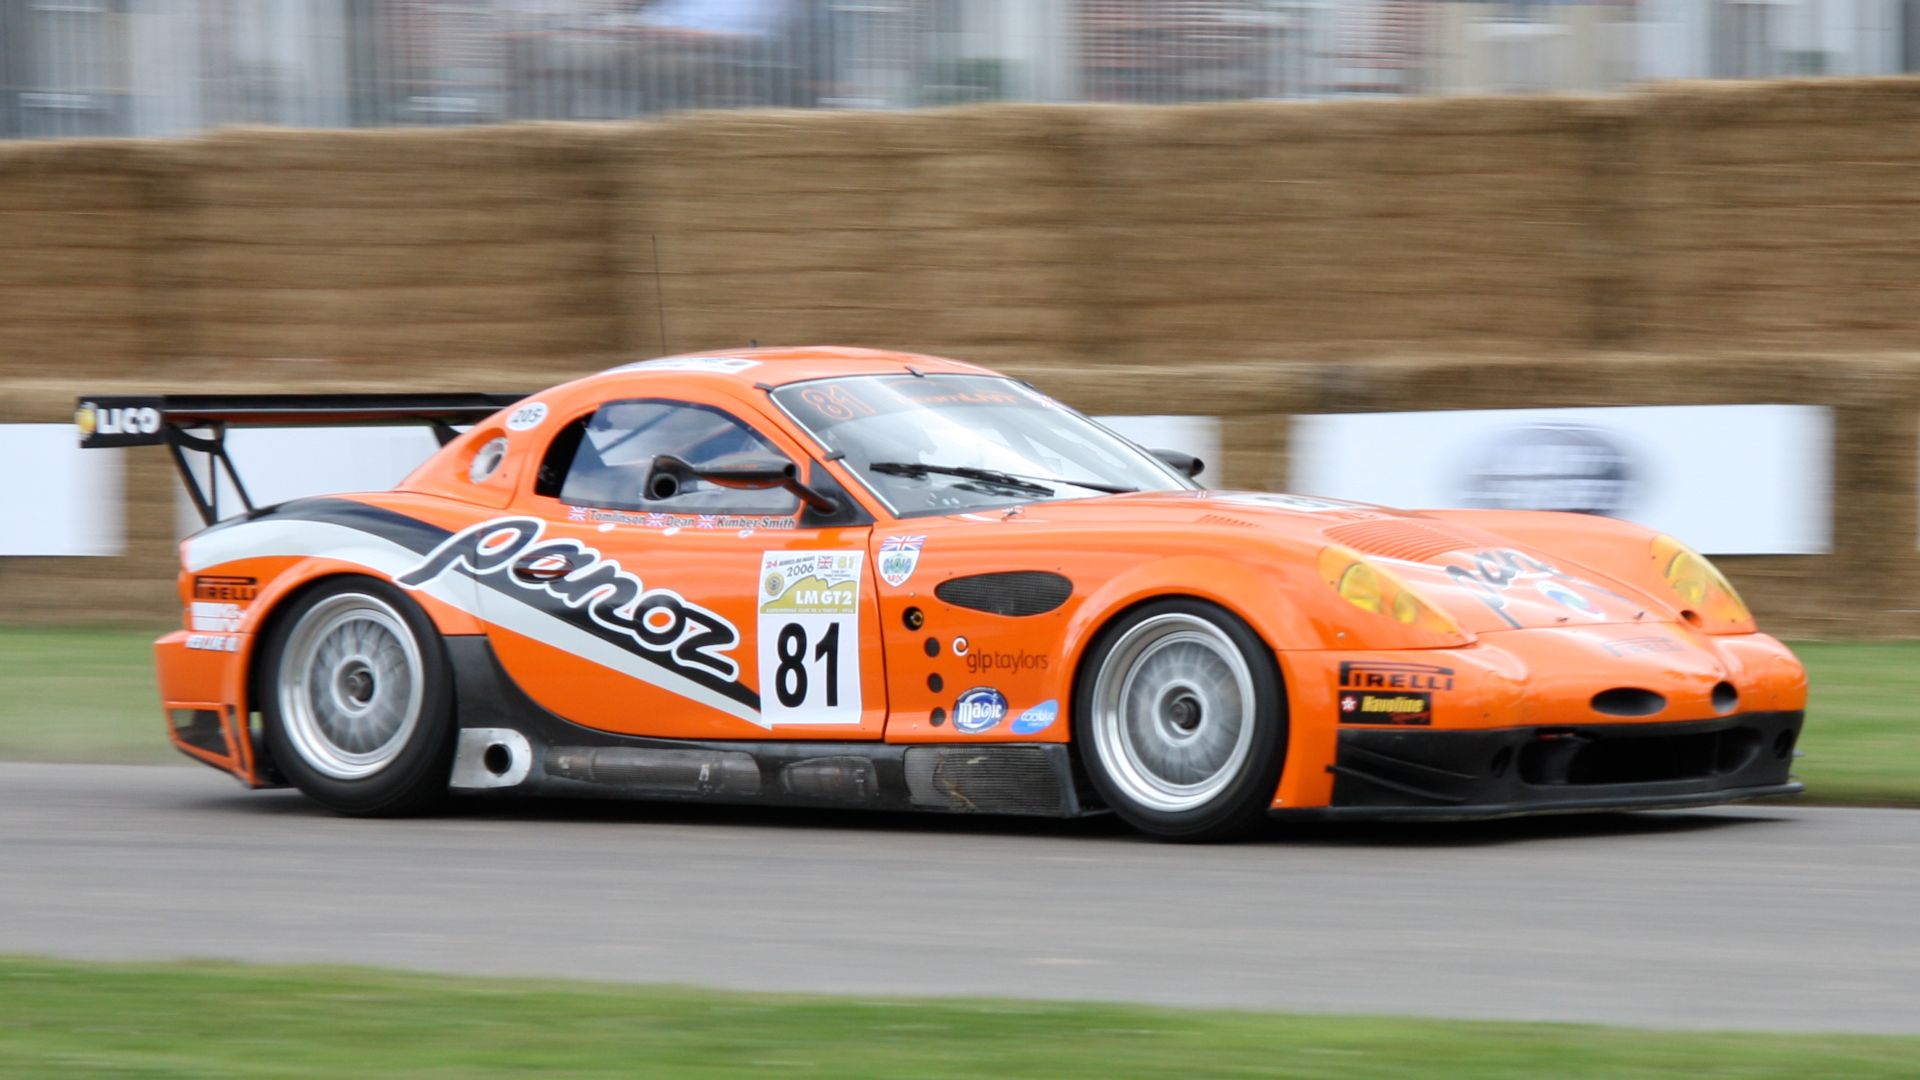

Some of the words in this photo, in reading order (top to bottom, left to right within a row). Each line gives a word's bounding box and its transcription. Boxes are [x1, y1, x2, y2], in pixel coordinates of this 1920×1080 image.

[801, 384, 877, 421] 81
[589, 510, 646, 525] Tomlinson
[664, 516, 695, 526] Dean
[787, 564, 815, 577] 2006
[796, 590, 818, 605] LM
[821, 590, 852, 605] GT2
[776, 622, 840, 708] 81
[966, 649, 993, 674] glp
[995, 649, 1049, 674] taylors
[1339, 661, 1454, 691] PIRELLI
